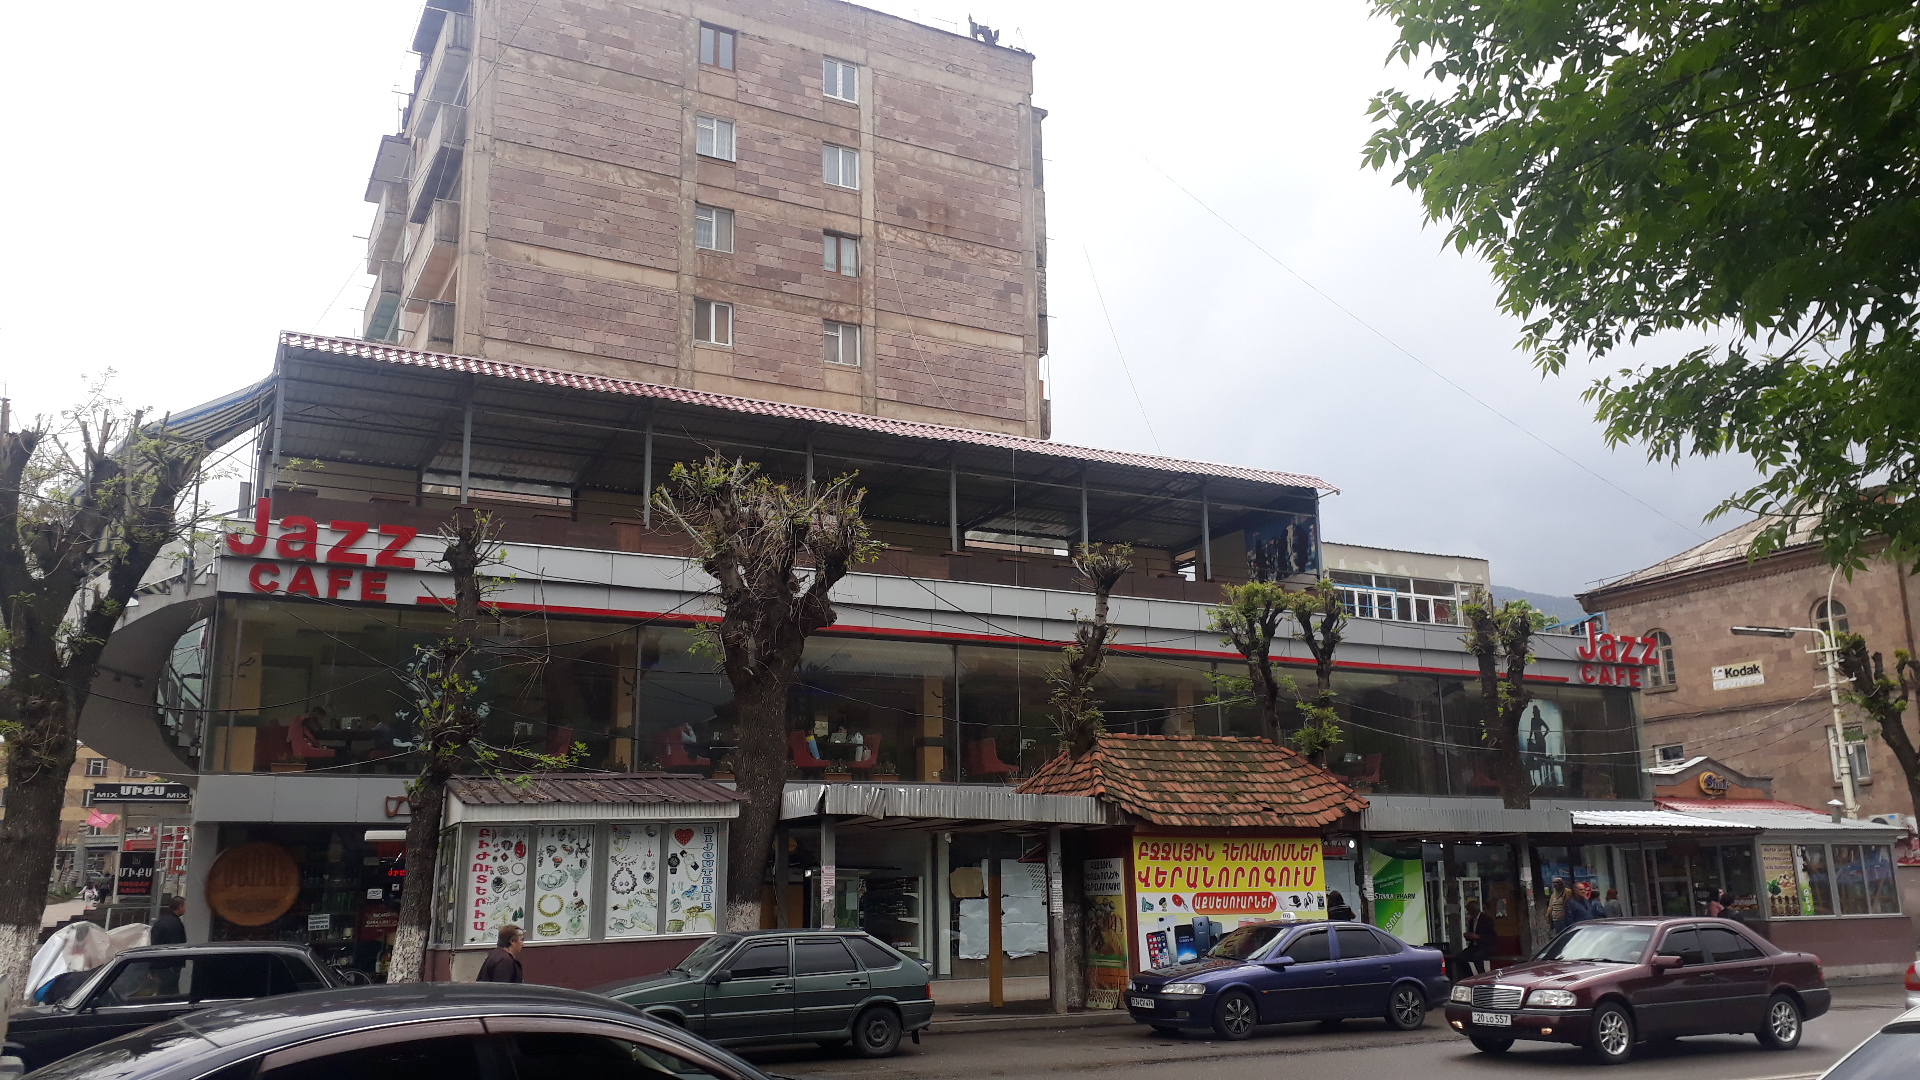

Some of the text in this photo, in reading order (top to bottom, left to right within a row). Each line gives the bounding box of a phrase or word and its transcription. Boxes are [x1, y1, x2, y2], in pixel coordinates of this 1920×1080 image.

[226, 497, 417, 568] Jazz
[249, 562, 388, 602] CAFE
[1578, 622, 1660, 665] Jazz
[1581, 664, 1642, 686] CAFE
[1724, 664, 1761, 678] Kodak
[120, 785, 165, 796] ՄԻՔՍ
[1137, 841, 1319, 863] ԲՋՋԱՅԻՆ ՀԵՌԱԽՈՍՆԵՐ
[120, 867, 153, 878] ՄԻՔՍ
[701, 827, 715, 910] BIJOUTERIE
[1137, 865, 1317, 889] ՎԵՐԱՆՈՐՈԳՈՒՄ
[1194, 895, 1275, 910] ԱՔՍԵՍՈՒԱՐՆԵՐ
[1494, 1014, 1509, 1024] 557
